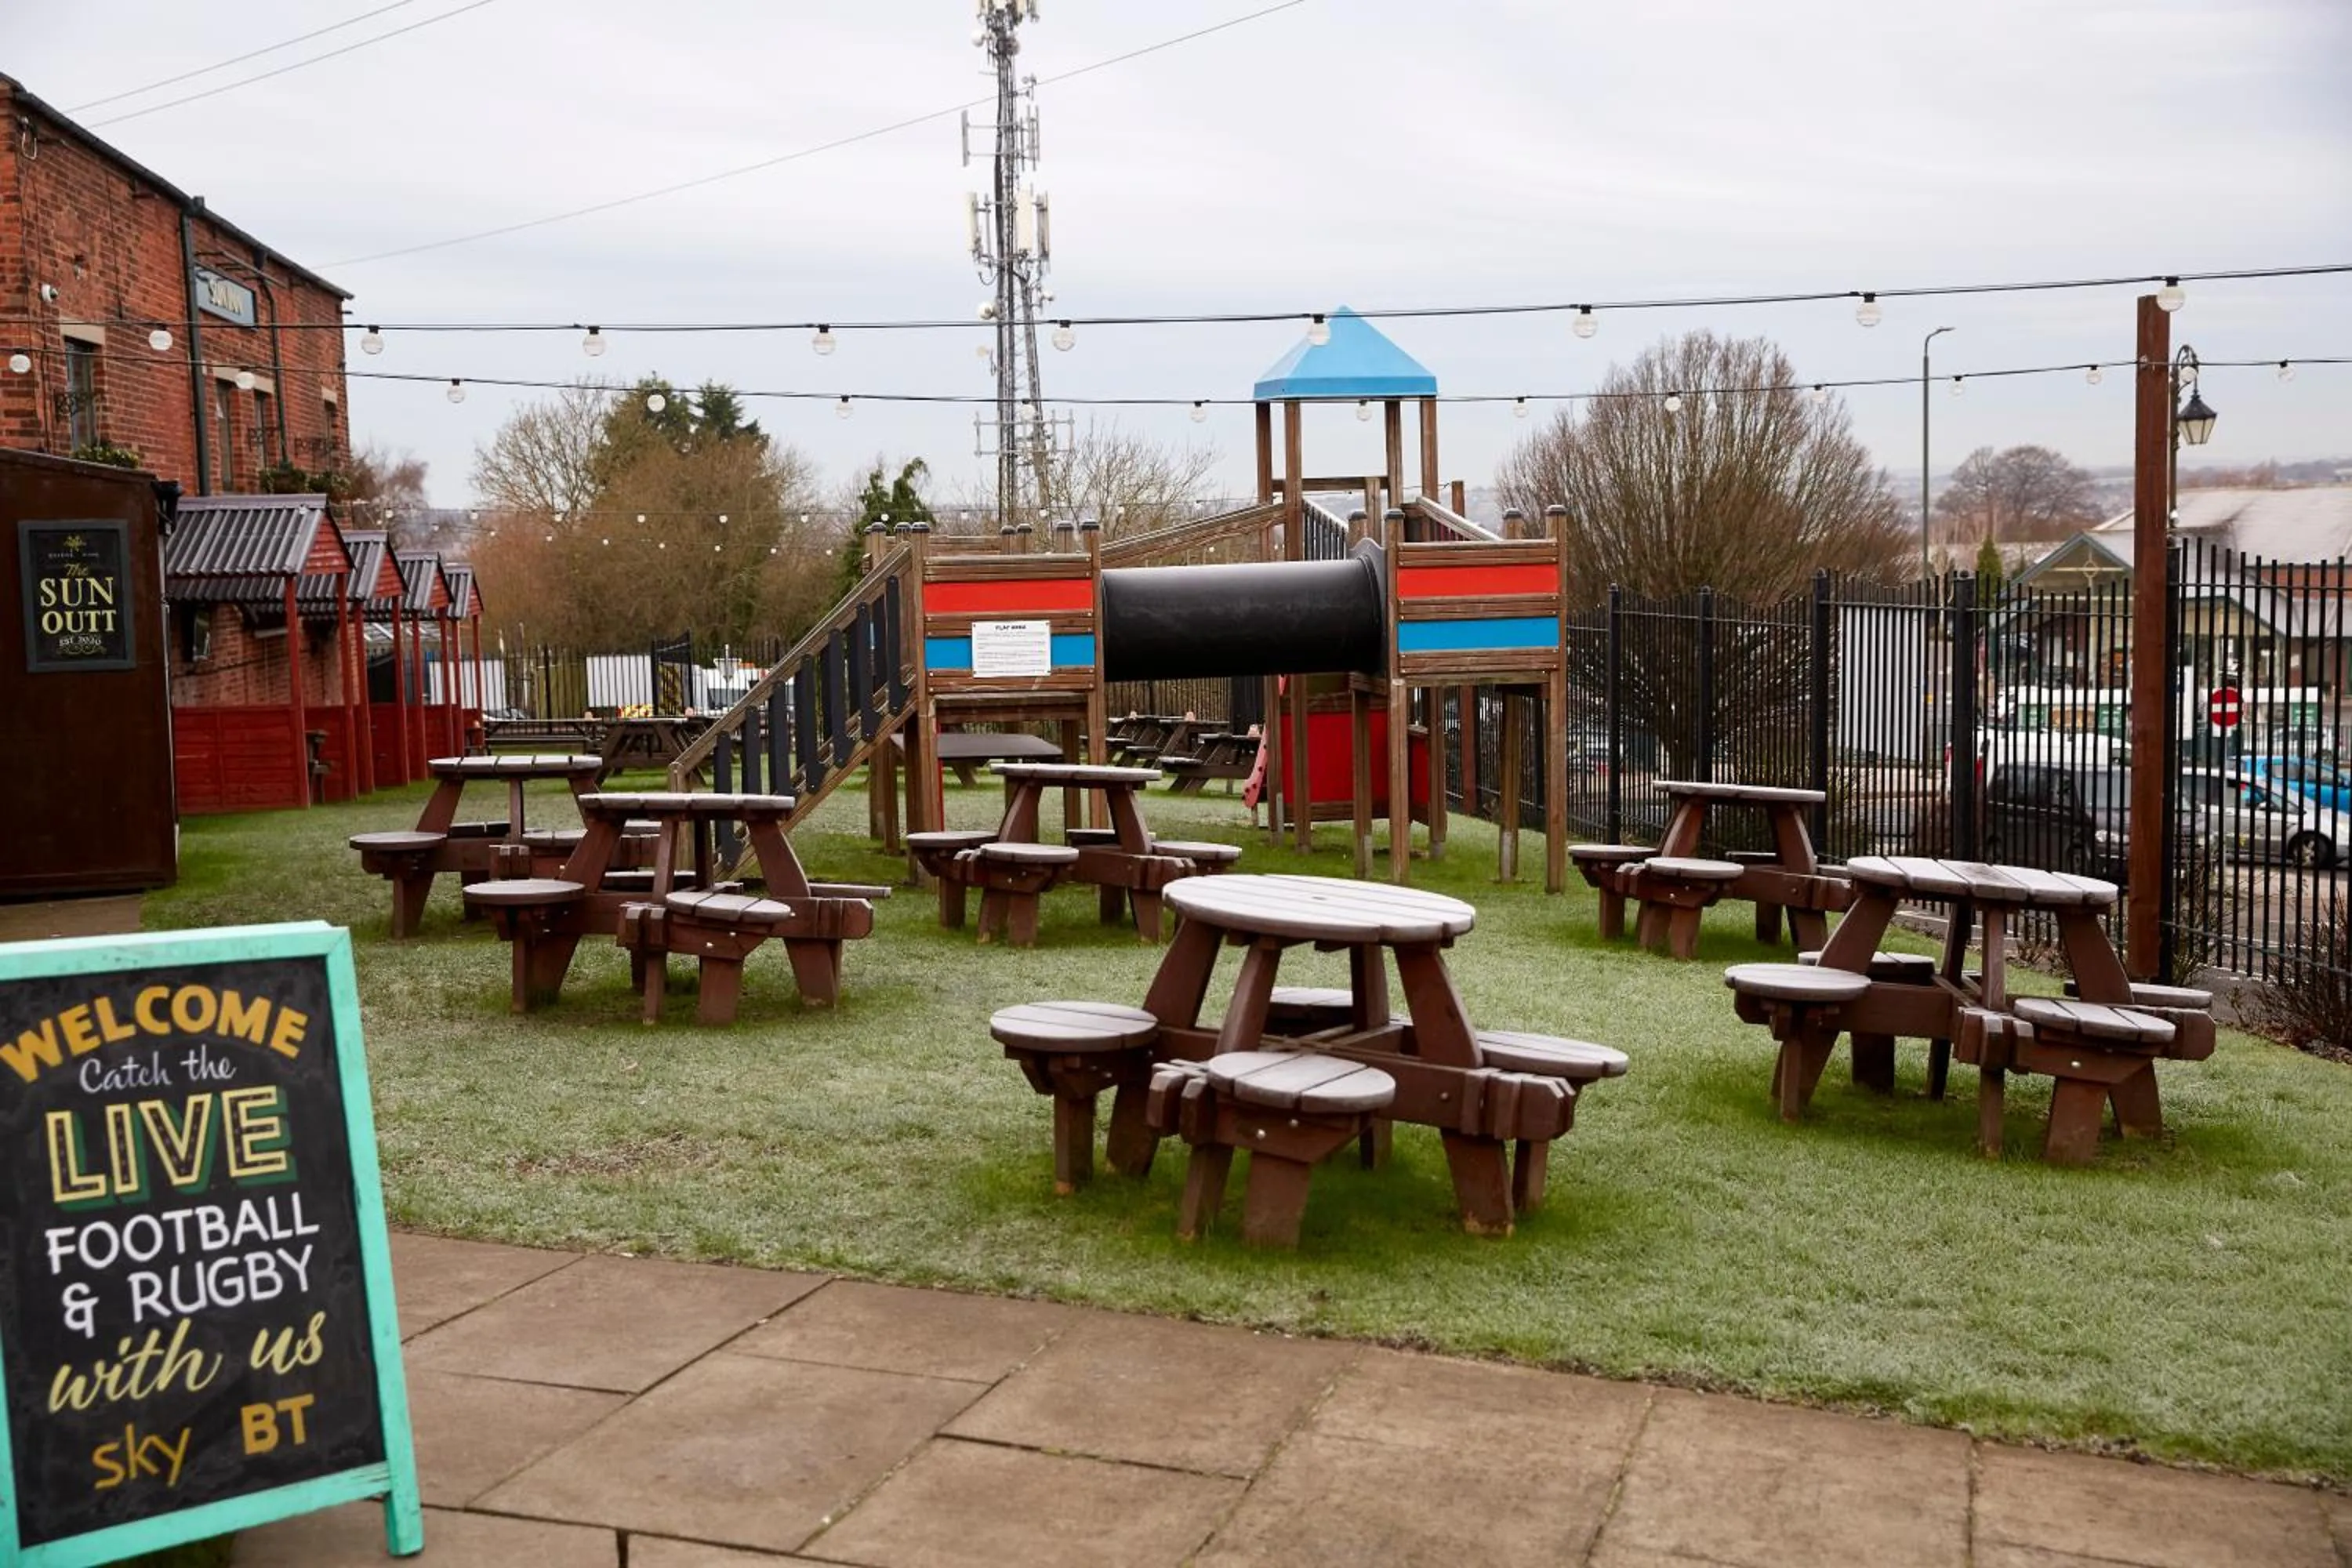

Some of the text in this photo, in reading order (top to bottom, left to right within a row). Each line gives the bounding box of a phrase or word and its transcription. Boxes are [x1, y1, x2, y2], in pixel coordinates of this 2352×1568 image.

[40, 576, 114, 607] SUN
[42, 610, 117, 634] OUTT
[0, 985, 307, 1083] WELCOME
[79, 1044, 237, 1093] Catch the
[45, 1085, 291, 1204] LIVE
[45, 1192, 320, 1276] FOOTBALL
[61, 1243, 314, 1340] & RUGBY
[48, 1310, 327, 1413] with us
[240, 1392, 314, 1456] BT
